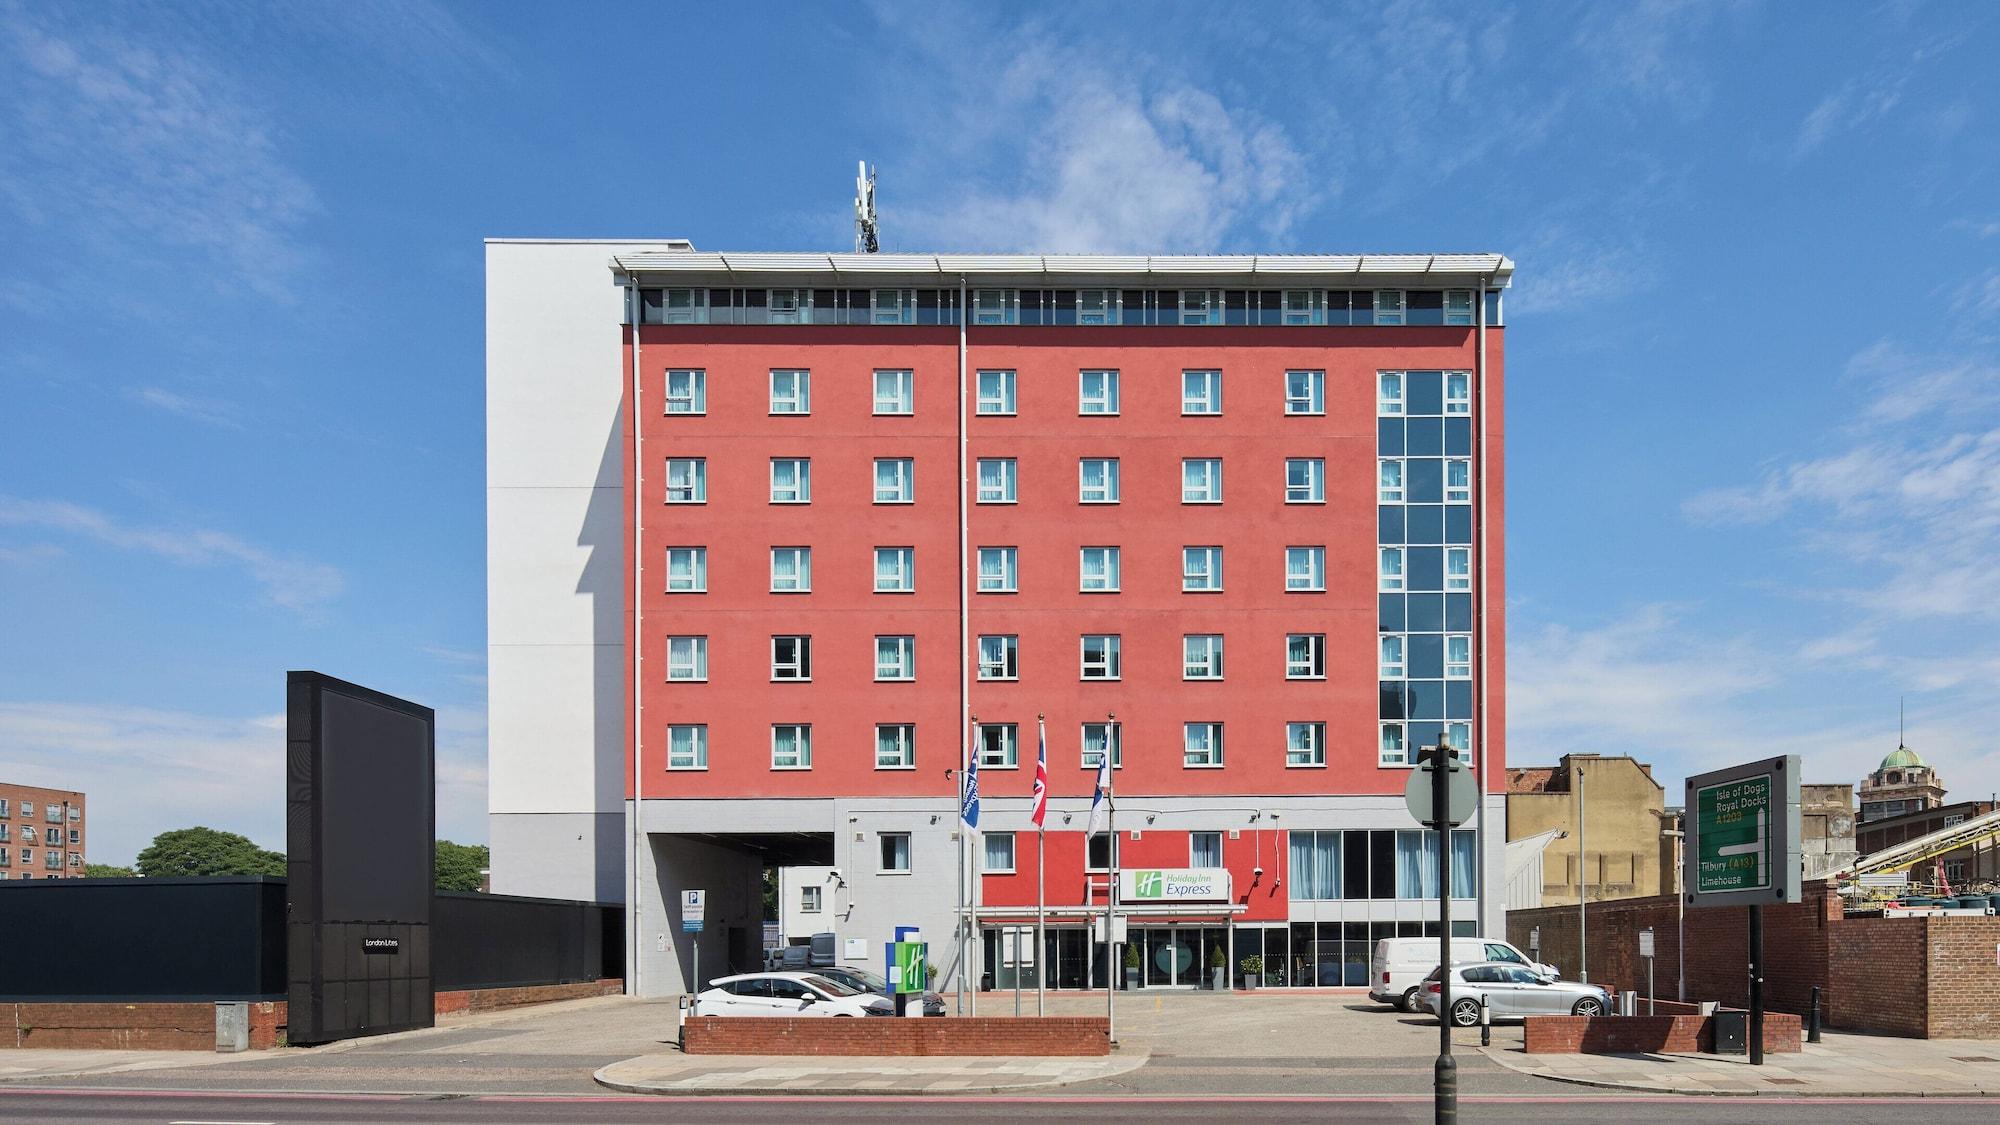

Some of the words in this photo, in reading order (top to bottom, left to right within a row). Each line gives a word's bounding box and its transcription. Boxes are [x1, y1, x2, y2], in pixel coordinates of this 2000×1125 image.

[1716, 789, 1730, 801] Isle
[1732, 786, 1742, 797] of
[1743, 783, 1765, 795] Dogs
[1716, 799, 1739, 813] Royal
[1741, 795, 1767, 808] Docks
[1701, 860, 1727, 872] Tilbury
[1166, 873, 1197, 884] Holiday
[1198, 873, 1211, 882] Inn
[1701, 875, 1742, 887] Limehouse
[1166, 883, 1211, 897] Express
